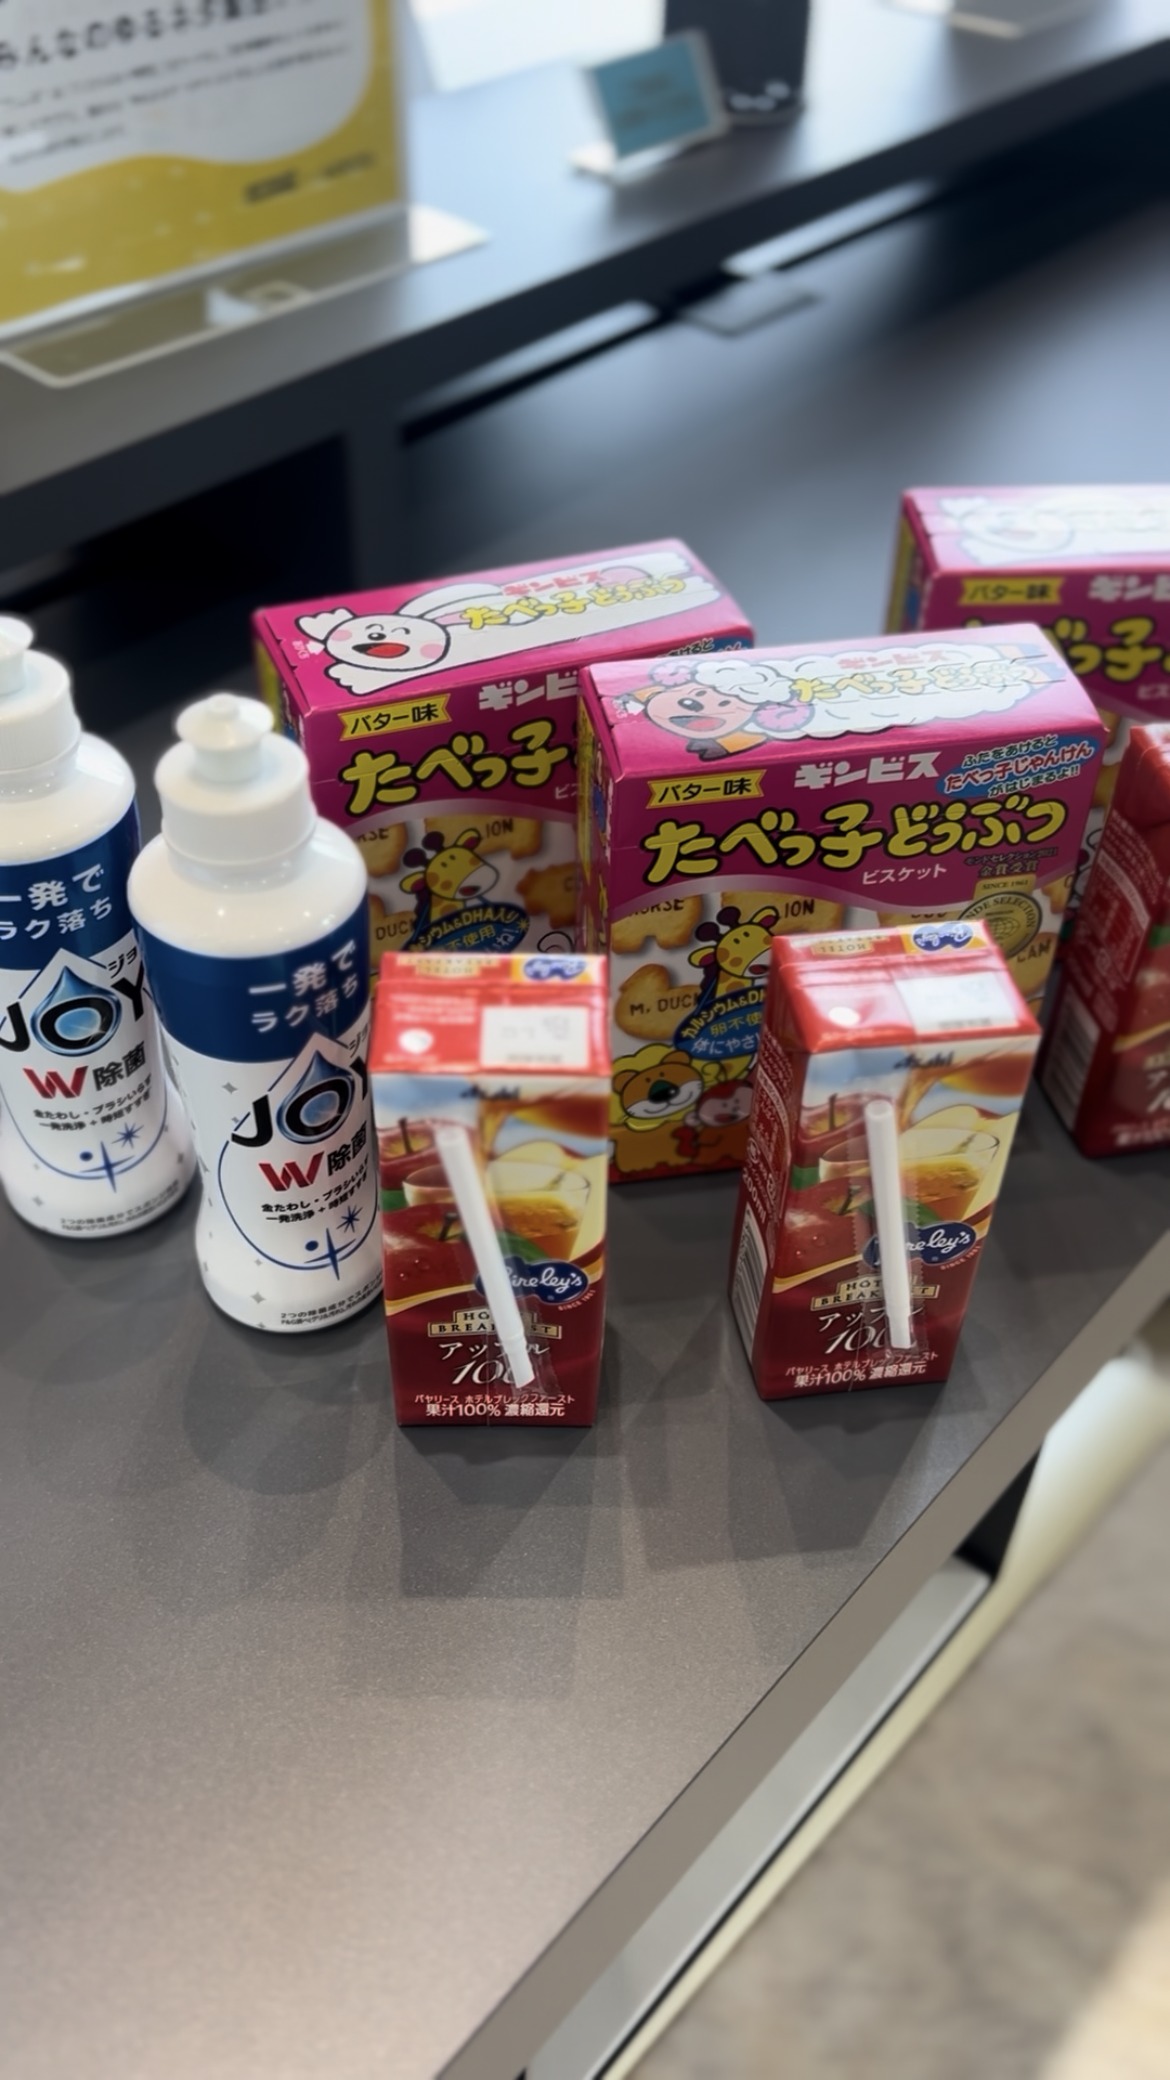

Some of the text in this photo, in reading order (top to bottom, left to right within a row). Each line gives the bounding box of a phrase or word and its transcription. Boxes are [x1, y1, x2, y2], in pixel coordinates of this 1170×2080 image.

[459, 576, 687, 630] たべっ子どうぶつ
[349, 703, 440, 735] バター味
[656, 752, 942, 803] バター味 ギンビス
[944, 740, 1095, 793] たべっ子じゃんけん
[961, 734, 1059, 769] ふたをあけると
[641, 795, 1072, 888] たべっ子どうぶつ
[861, 862, 948, 885] ビスケット
[248, 939, 357, 997] 一発で
[0, 960, 145, 1053] JOY
[251, 973, 359, 1033] ラク落ち
[793, 1369, 866, 1388] 果汁100%
[425, 1403, 566, 1417] 果汁100% 濃縮還元
